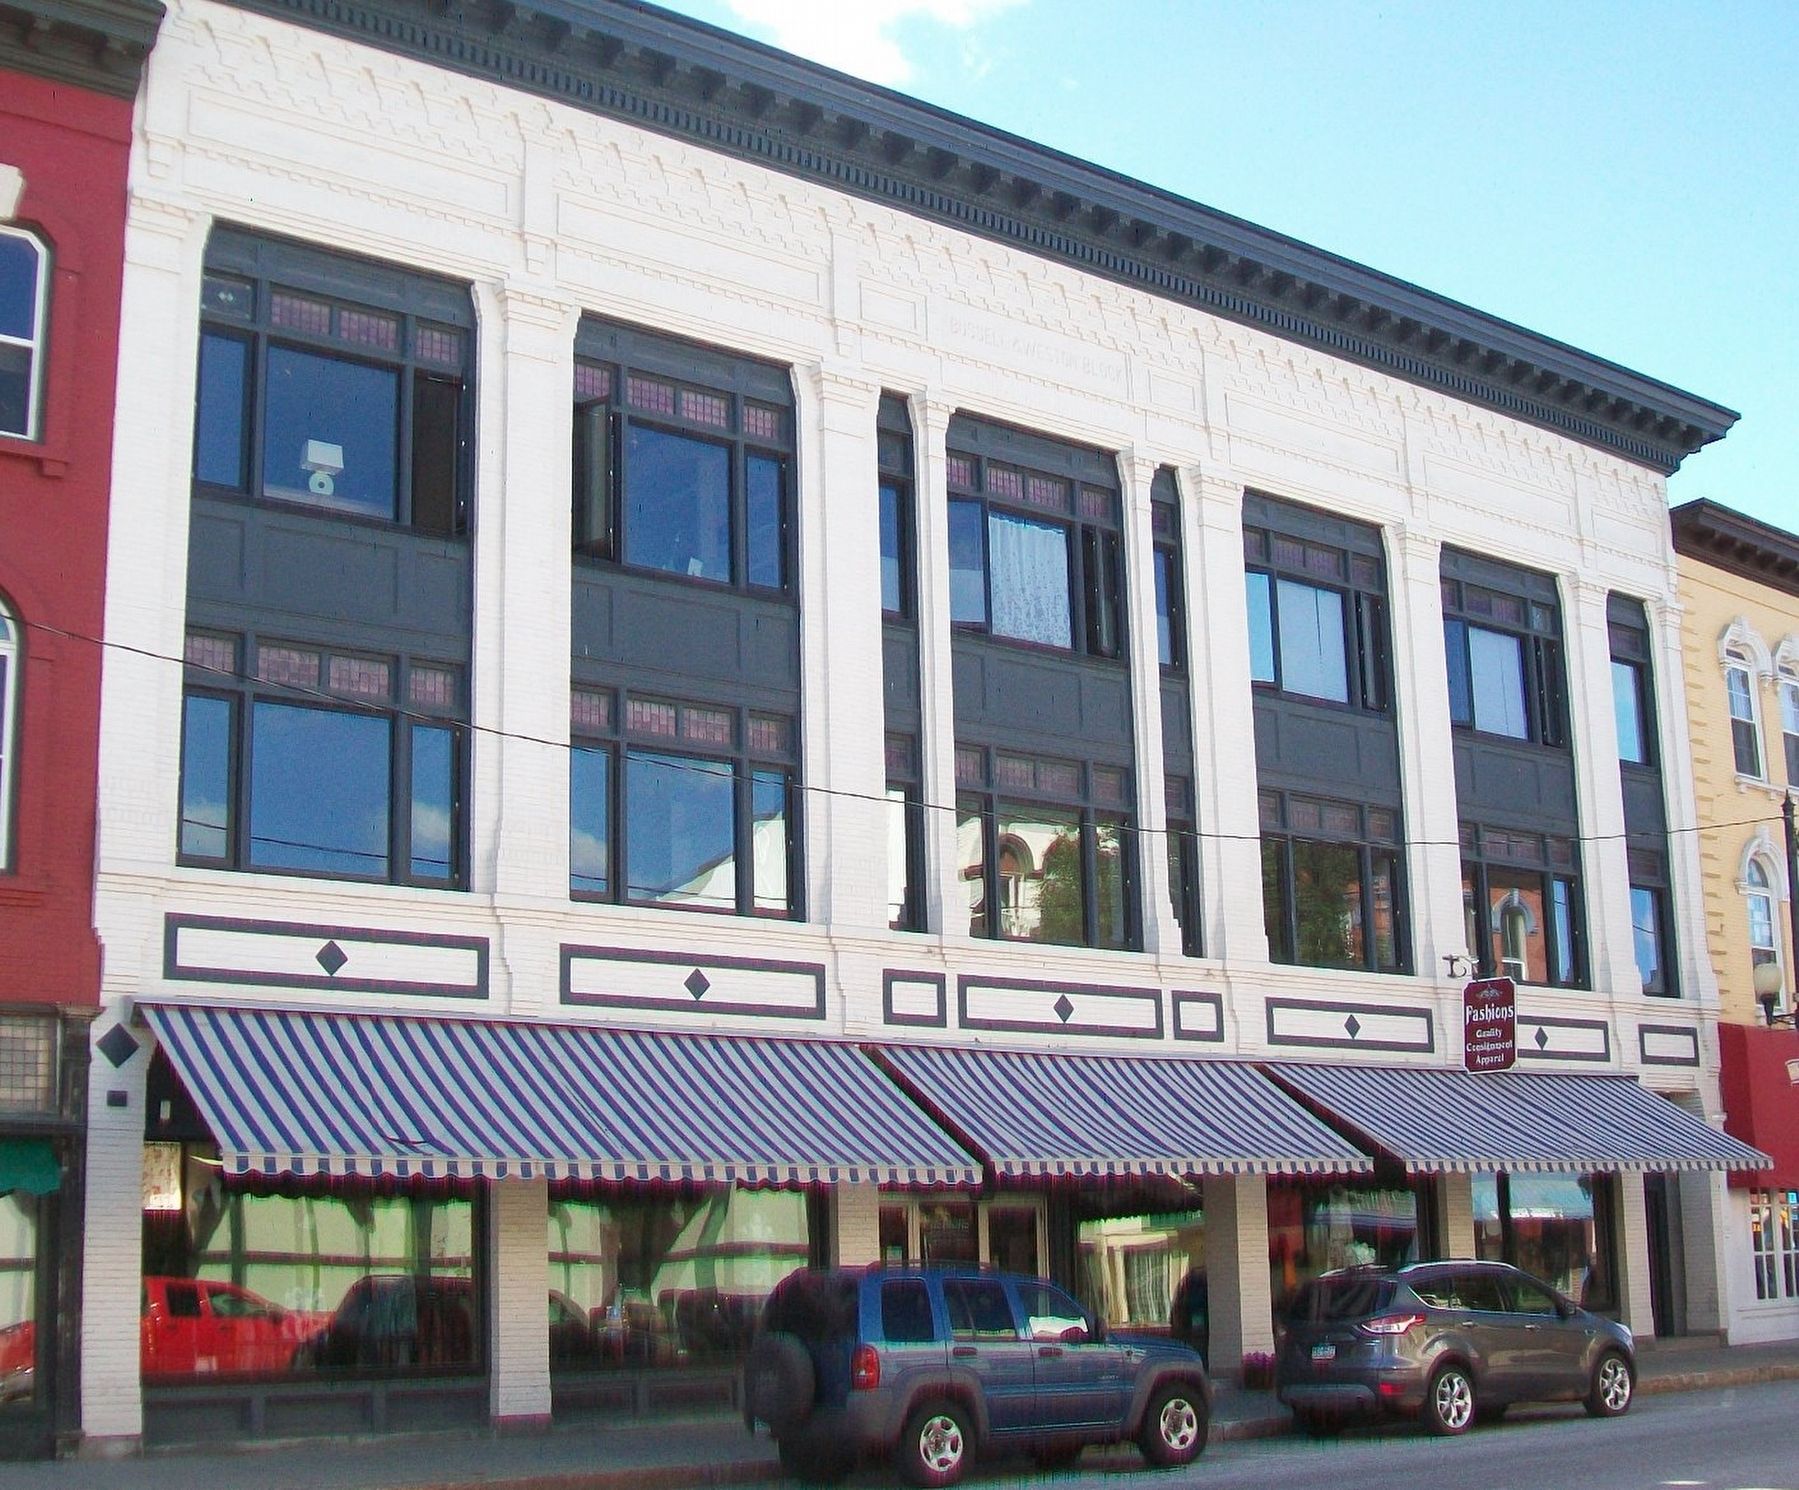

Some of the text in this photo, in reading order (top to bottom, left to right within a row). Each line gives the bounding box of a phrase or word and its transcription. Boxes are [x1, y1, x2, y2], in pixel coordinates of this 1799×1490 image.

[1081, 354, 1122, 382] BLOCK
[1466, 1003, 1513, 1025] Fashions
[1475, 1054, 1504, 1065] Apparel
